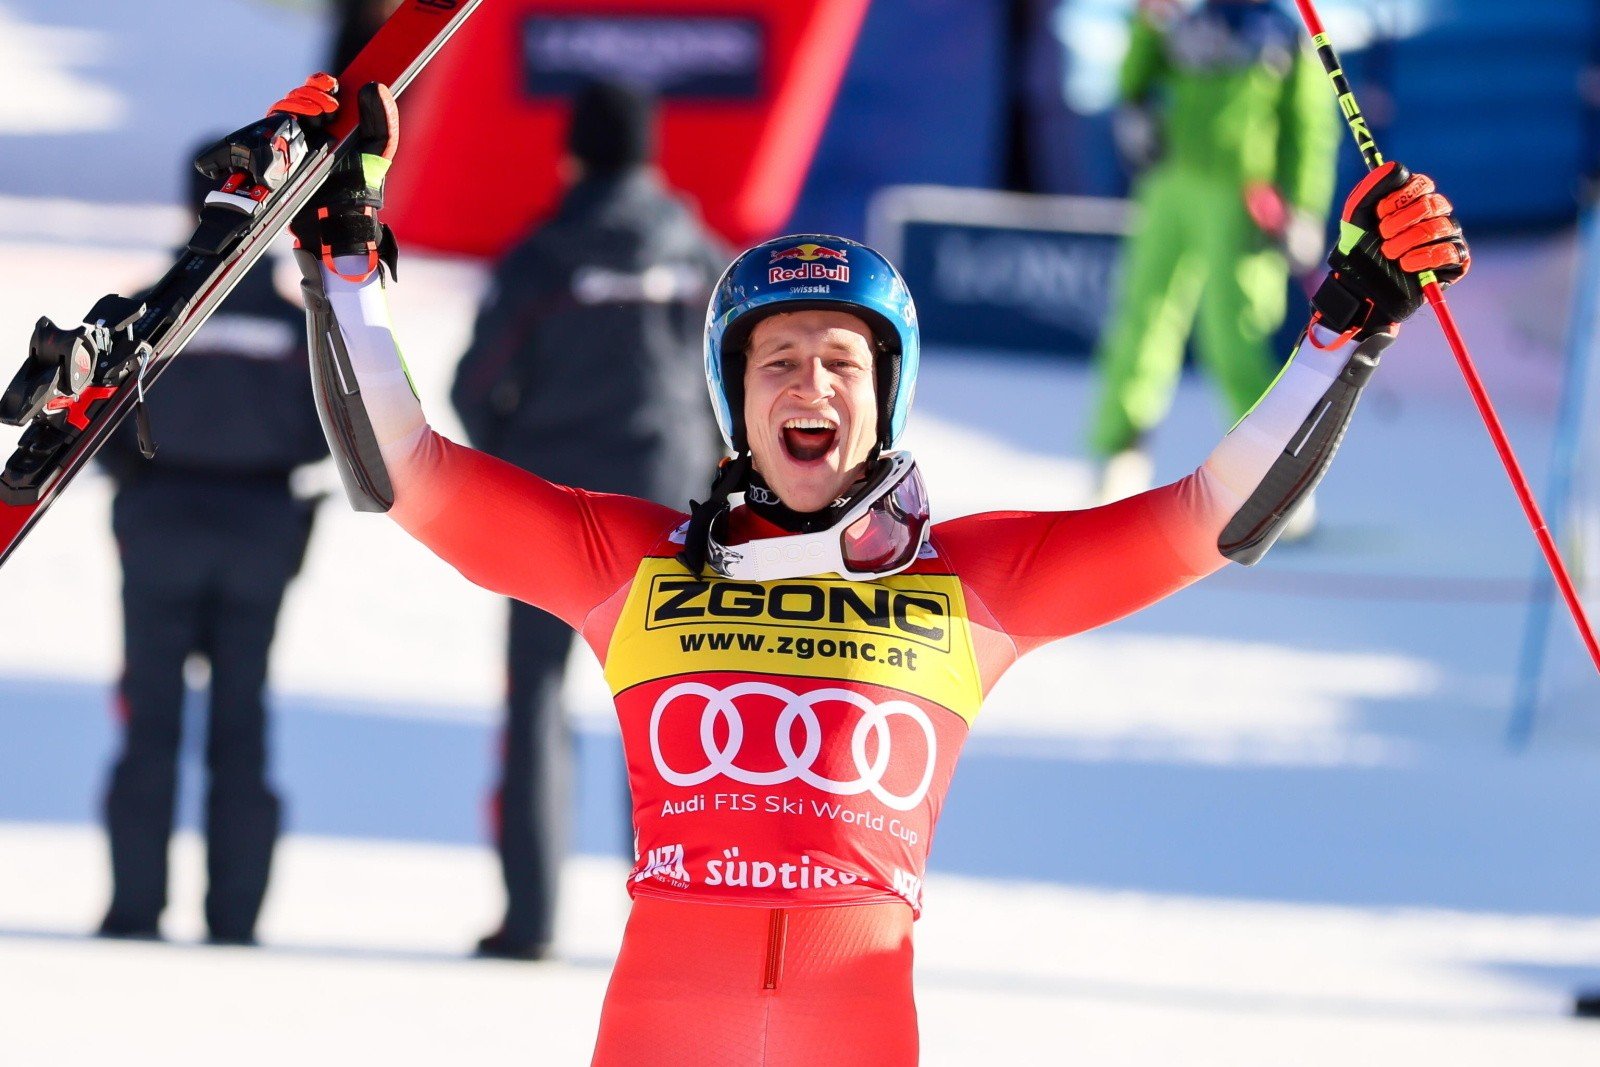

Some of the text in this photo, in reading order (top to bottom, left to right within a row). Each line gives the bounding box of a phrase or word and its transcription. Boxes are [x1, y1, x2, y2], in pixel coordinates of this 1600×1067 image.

[1328, 68, 1375, 152] LEKI
[769, 263, 850, 284] Red Bull
[654, 581, 944, 641] ZGONC
[680, 633, 917, 671] www.zgonc.at
[661, 793, 918, 847] Audi FIS Ski World Cup
